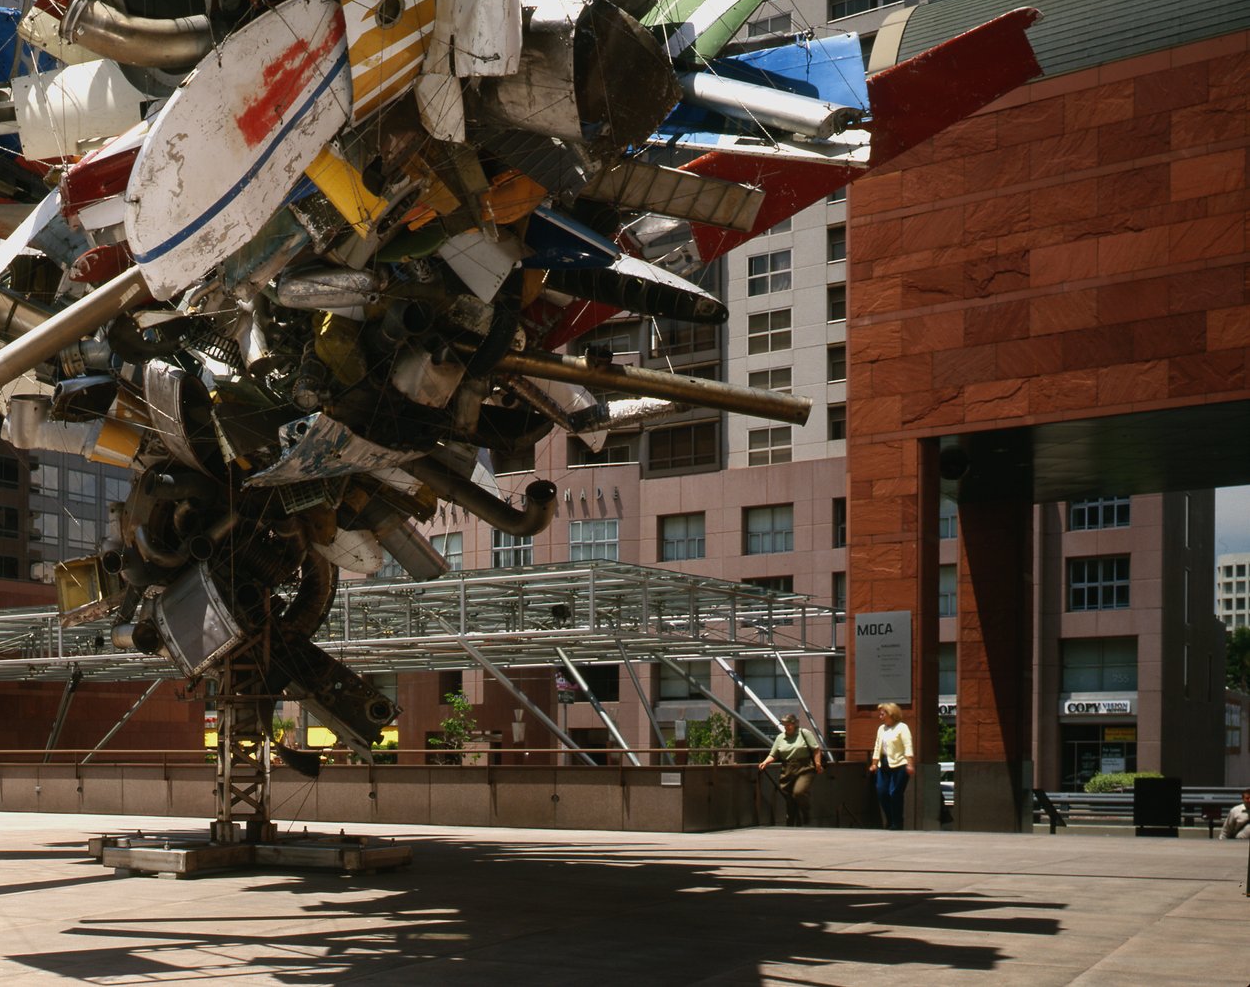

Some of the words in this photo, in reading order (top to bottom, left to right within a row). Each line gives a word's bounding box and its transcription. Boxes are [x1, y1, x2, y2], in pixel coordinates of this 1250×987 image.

[857, 623, 893, 636] MOCA
[1067, 702, 1101, 713] COPY
[1102, 702, 1128, 710] VISION
